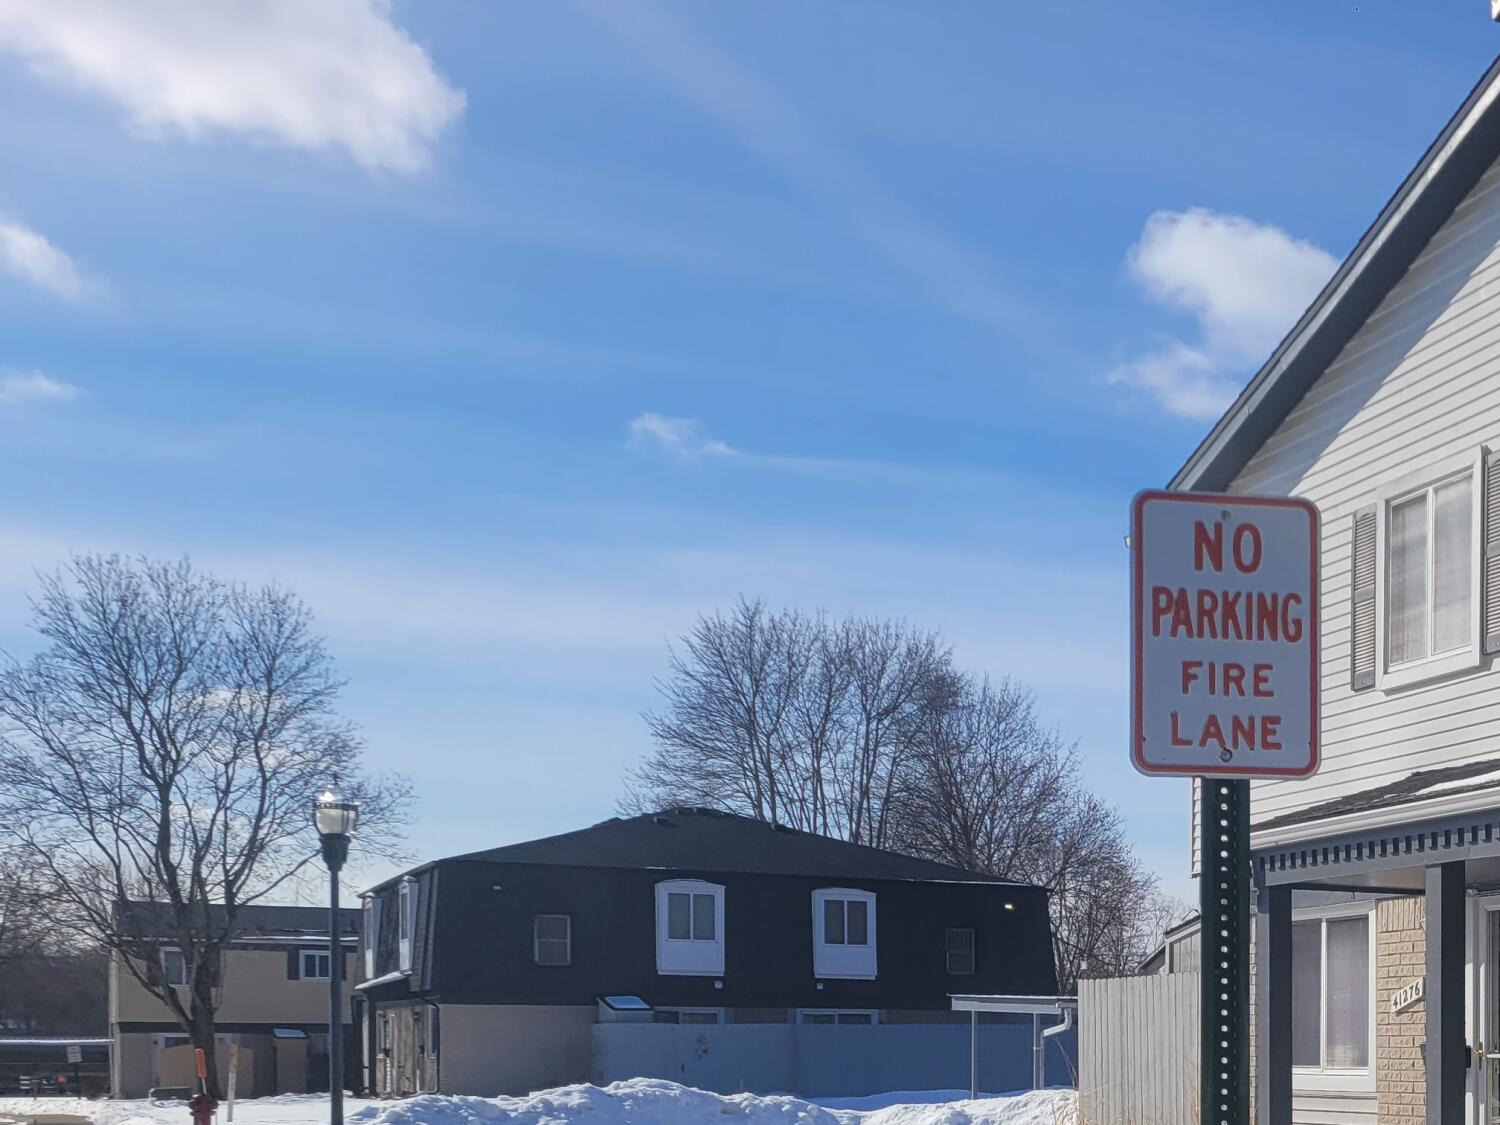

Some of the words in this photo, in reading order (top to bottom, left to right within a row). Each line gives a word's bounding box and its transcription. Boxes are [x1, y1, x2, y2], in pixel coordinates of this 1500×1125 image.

[1193, 519, 1263, 574] NO
[1151, 585, 1303, 644] PARKING
[1181, 660, 1275, 698] FIRE
[1170, 709, 1283, 751] LANE
[1392, 981, 1421, 1009] 41276
